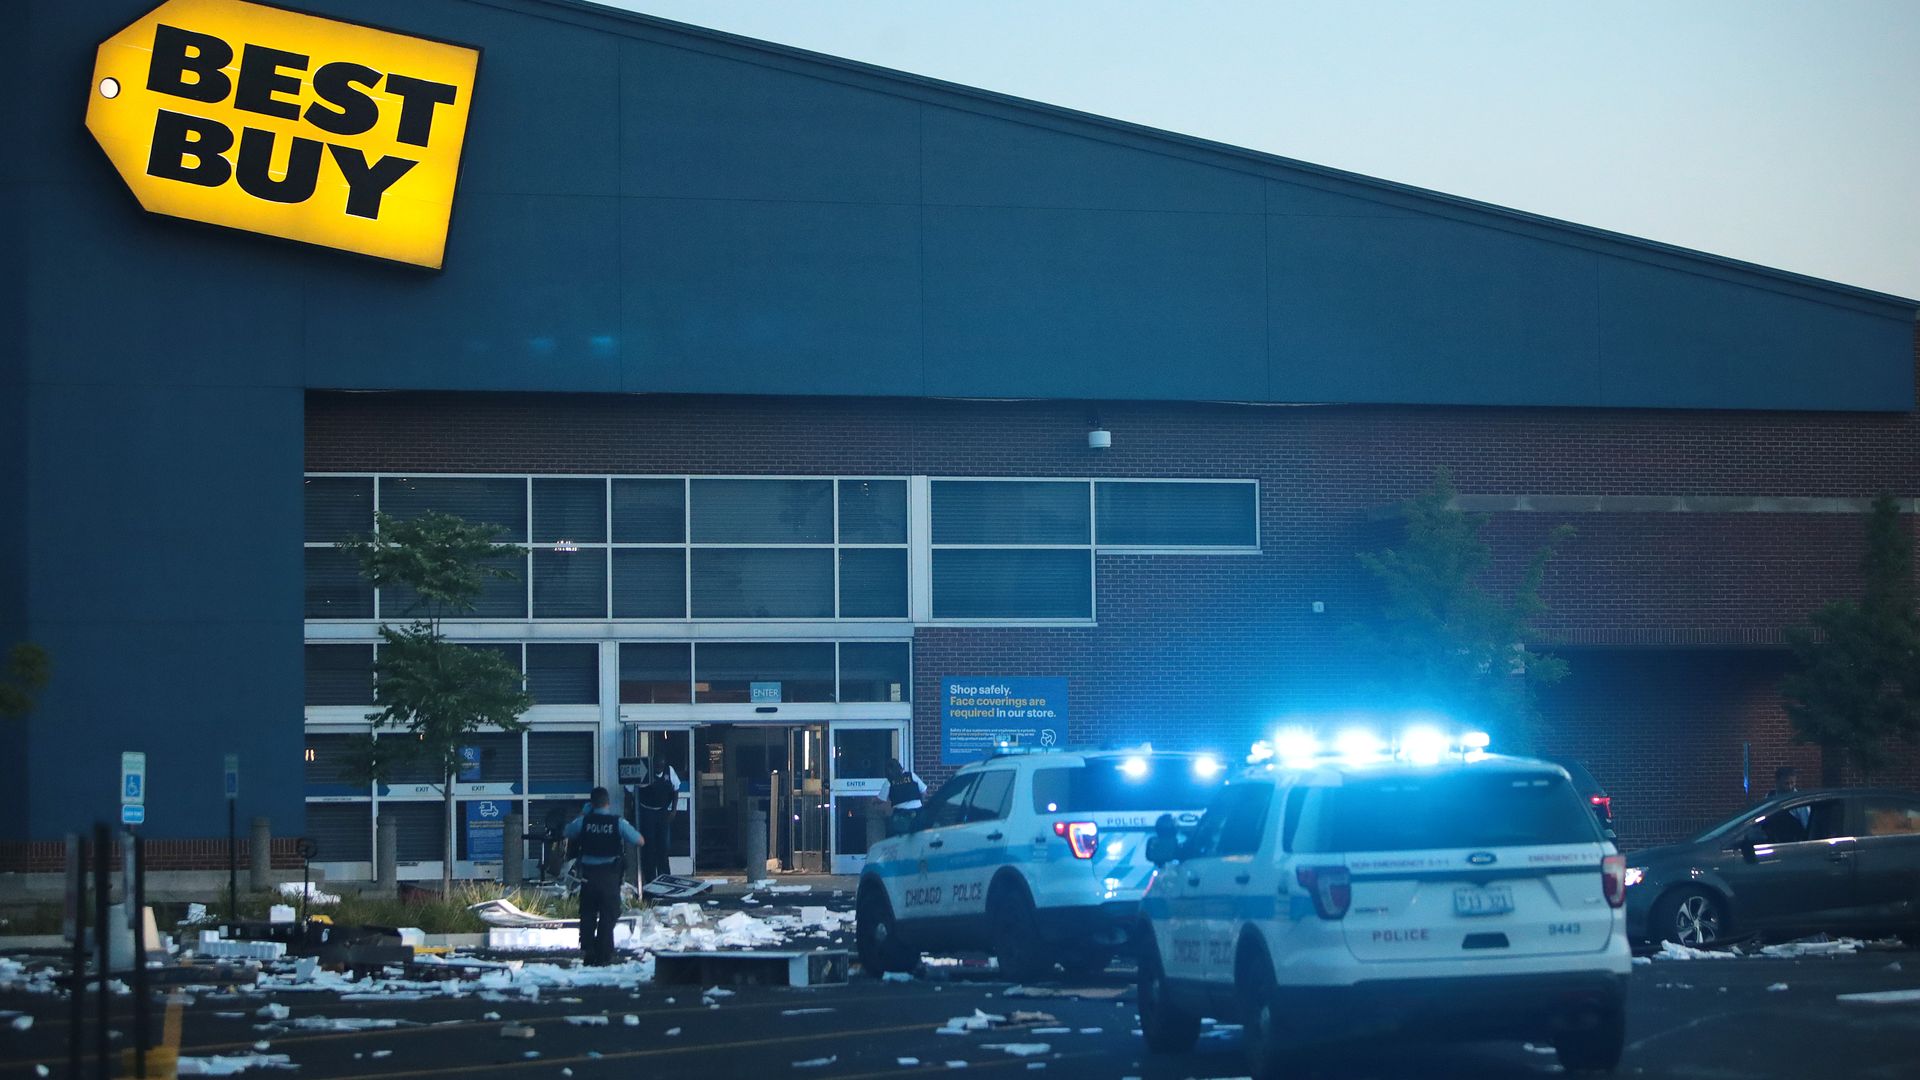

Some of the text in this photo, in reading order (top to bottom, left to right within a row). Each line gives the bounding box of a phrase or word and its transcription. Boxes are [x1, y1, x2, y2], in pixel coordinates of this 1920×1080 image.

[147, 23, 458, 148] BEST
[147, 108, 419, 221] BUY
[753, 688, 779, 697] ENTER
[950, 684, 1012, 697] Shop safely.
[950, 696, 1046, 708] Face coverings are
[950, 708, 1057, 719] required in our store.
[846, 780, 866, 788] ENTER
[1107, 816, 1146, 825] POLICE
[586, 823, 614, 834] POLICE
[905, 881, 982, 908] CHICAGO POLICE
[1372, 928, 1429, 942] POLICE
